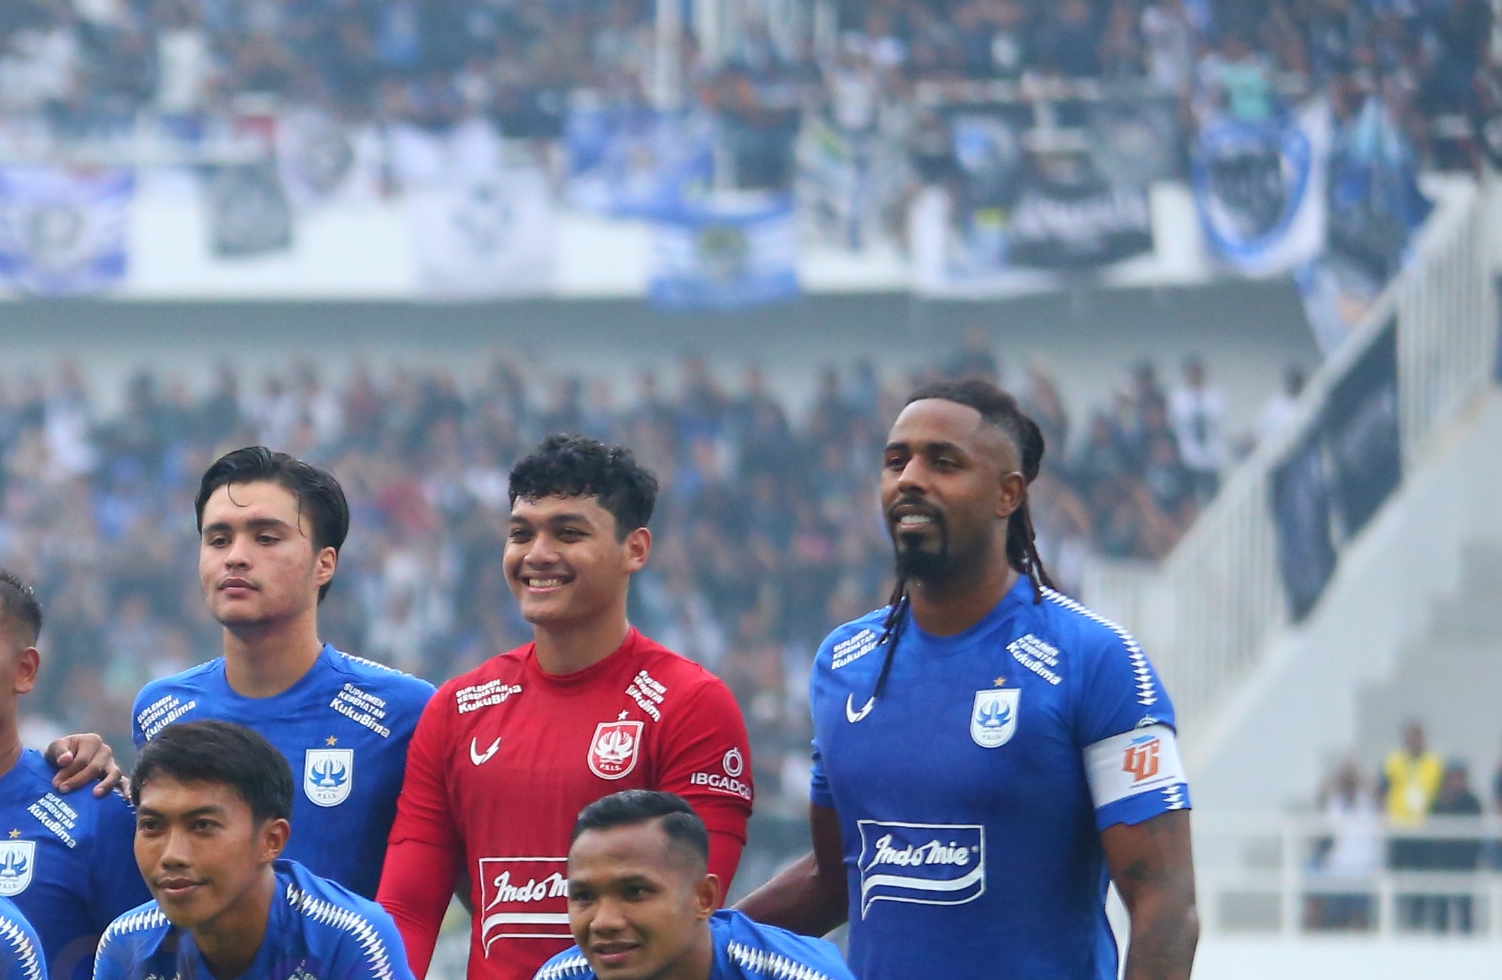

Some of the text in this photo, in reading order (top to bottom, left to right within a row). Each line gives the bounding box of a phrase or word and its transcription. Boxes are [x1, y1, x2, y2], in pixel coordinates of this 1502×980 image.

[344, 683, 386, 708] SUPLEMEN
[456, 679, 500, 697] SUPLEMEN
[457, 685, 508, 704] KESEHATAN
[137, 695, 172, 723] SUPLEMEN
[141, 699, 180, 731] KESEHATAN
[329, 698, 390, 738] KukuBima
[338, 691, 385, 719] KESEHATAN
[145, 700, 196, 741] KukuBima
[27, 804, 76, 848] KukuBima
